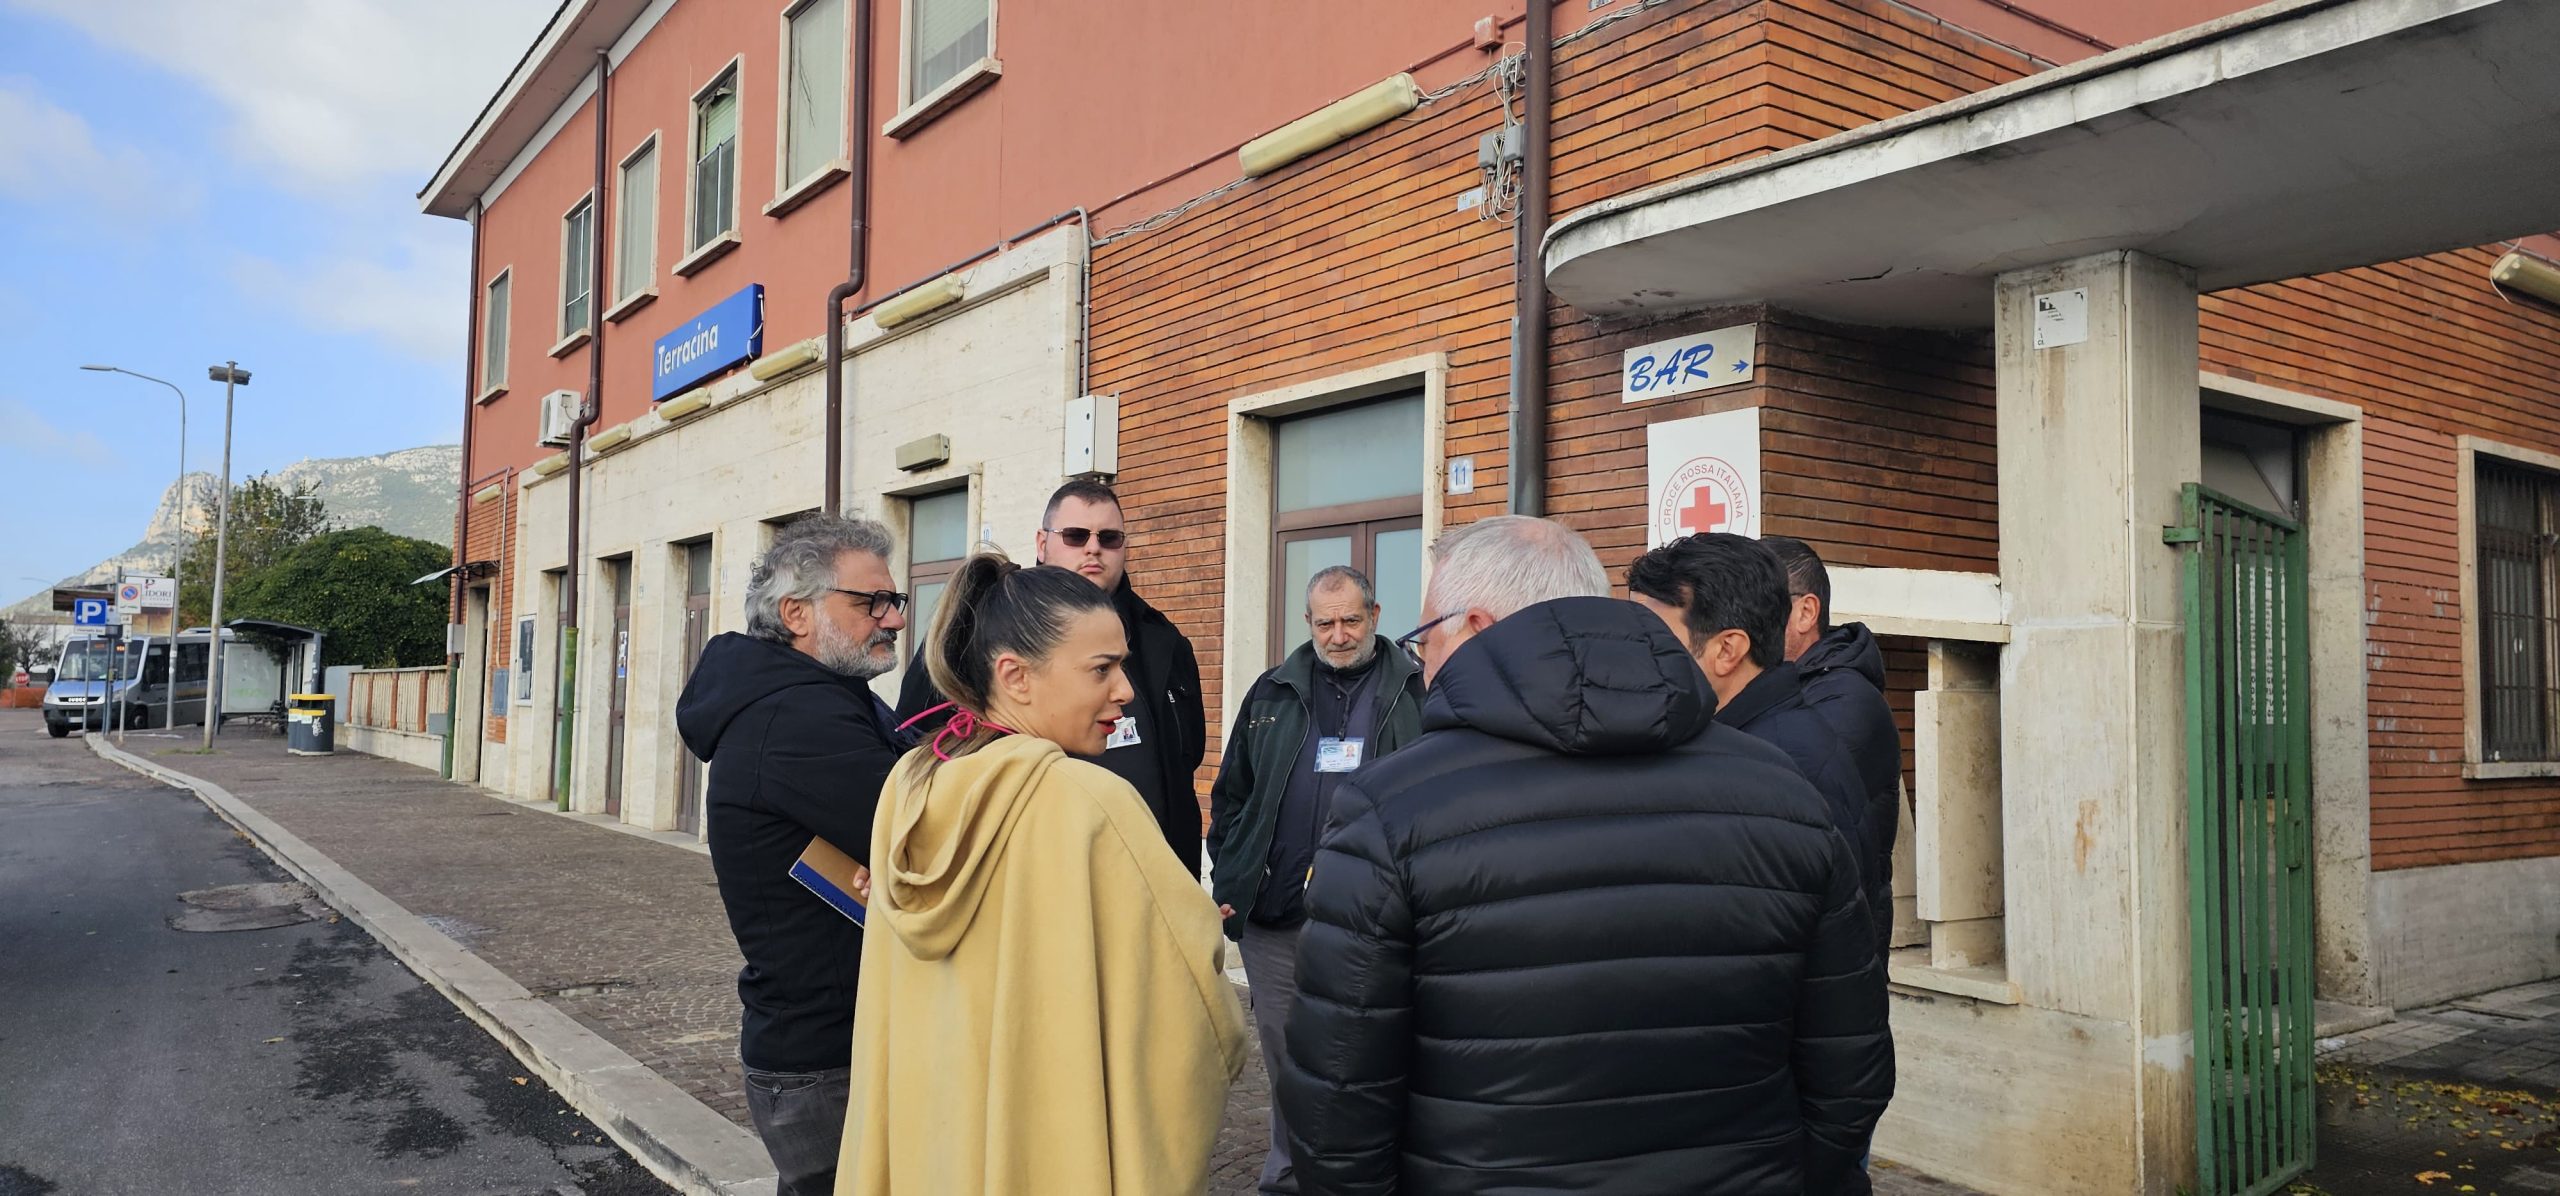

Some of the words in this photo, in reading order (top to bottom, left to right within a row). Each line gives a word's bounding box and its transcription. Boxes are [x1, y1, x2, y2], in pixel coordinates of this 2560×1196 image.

[658, 321, 718, 377] Terracina
[1629, 343, 1714, 392] BAR
[1454, 464, 1466, 486] 11
[1663, 481, 1682, 526] CROCE
[1681, 464, 1714, 483] ROSSA
[1716, 467, 1744, 519] ITALIANA
[82, 601, 102, 624] P
